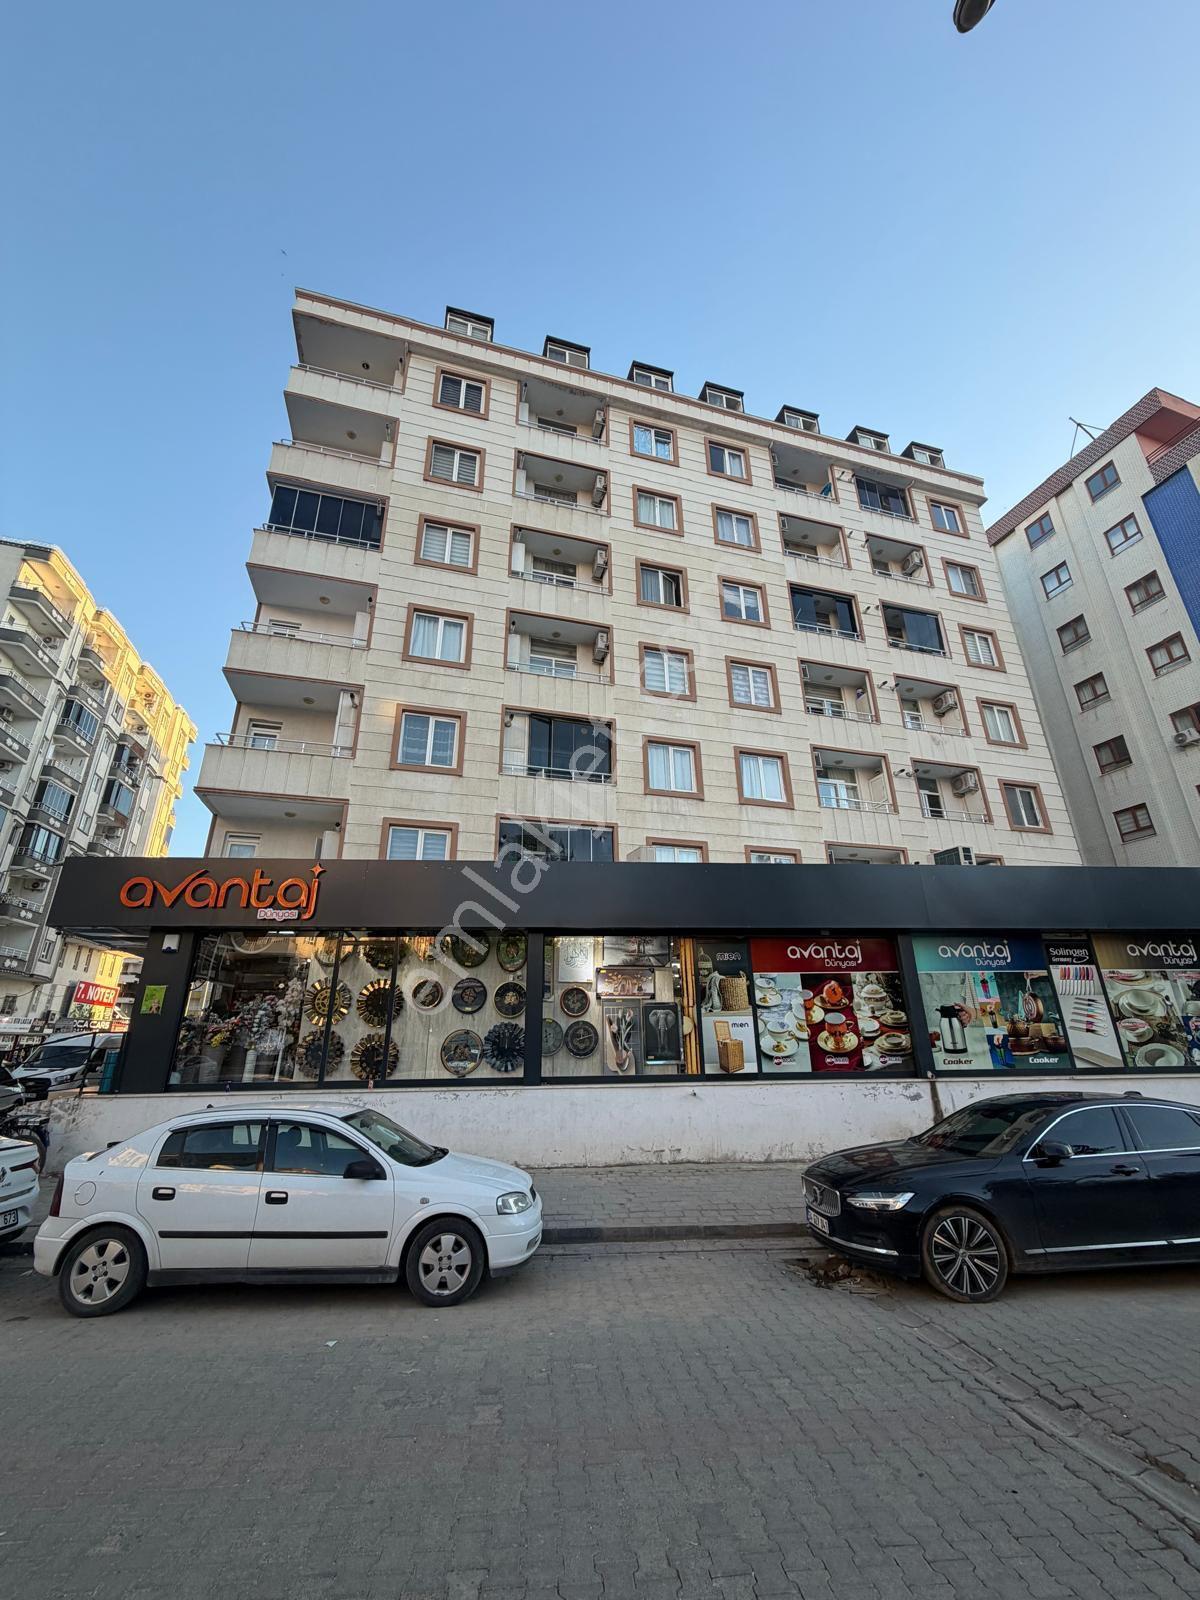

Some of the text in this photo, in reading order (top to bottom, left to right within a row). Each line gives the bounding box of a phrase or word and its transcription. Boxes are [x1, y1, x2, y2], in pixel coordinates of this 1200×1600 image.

[119, 863, 326, 920] avantaj
[786, 939, 862, 964] avantaj
[938, 939, 1011, 963] avantaj
[1049, 947, 1089, 959] Solingen
[1126, 939, 1197, 962] avantaj
[824, 958, 857, 969] Dünyası
[77, 983, 115, 1003] 7. NOTER
[1028, 1056, 1060, 1064] Cooker
[3, 1211, 16, 1224] 673
